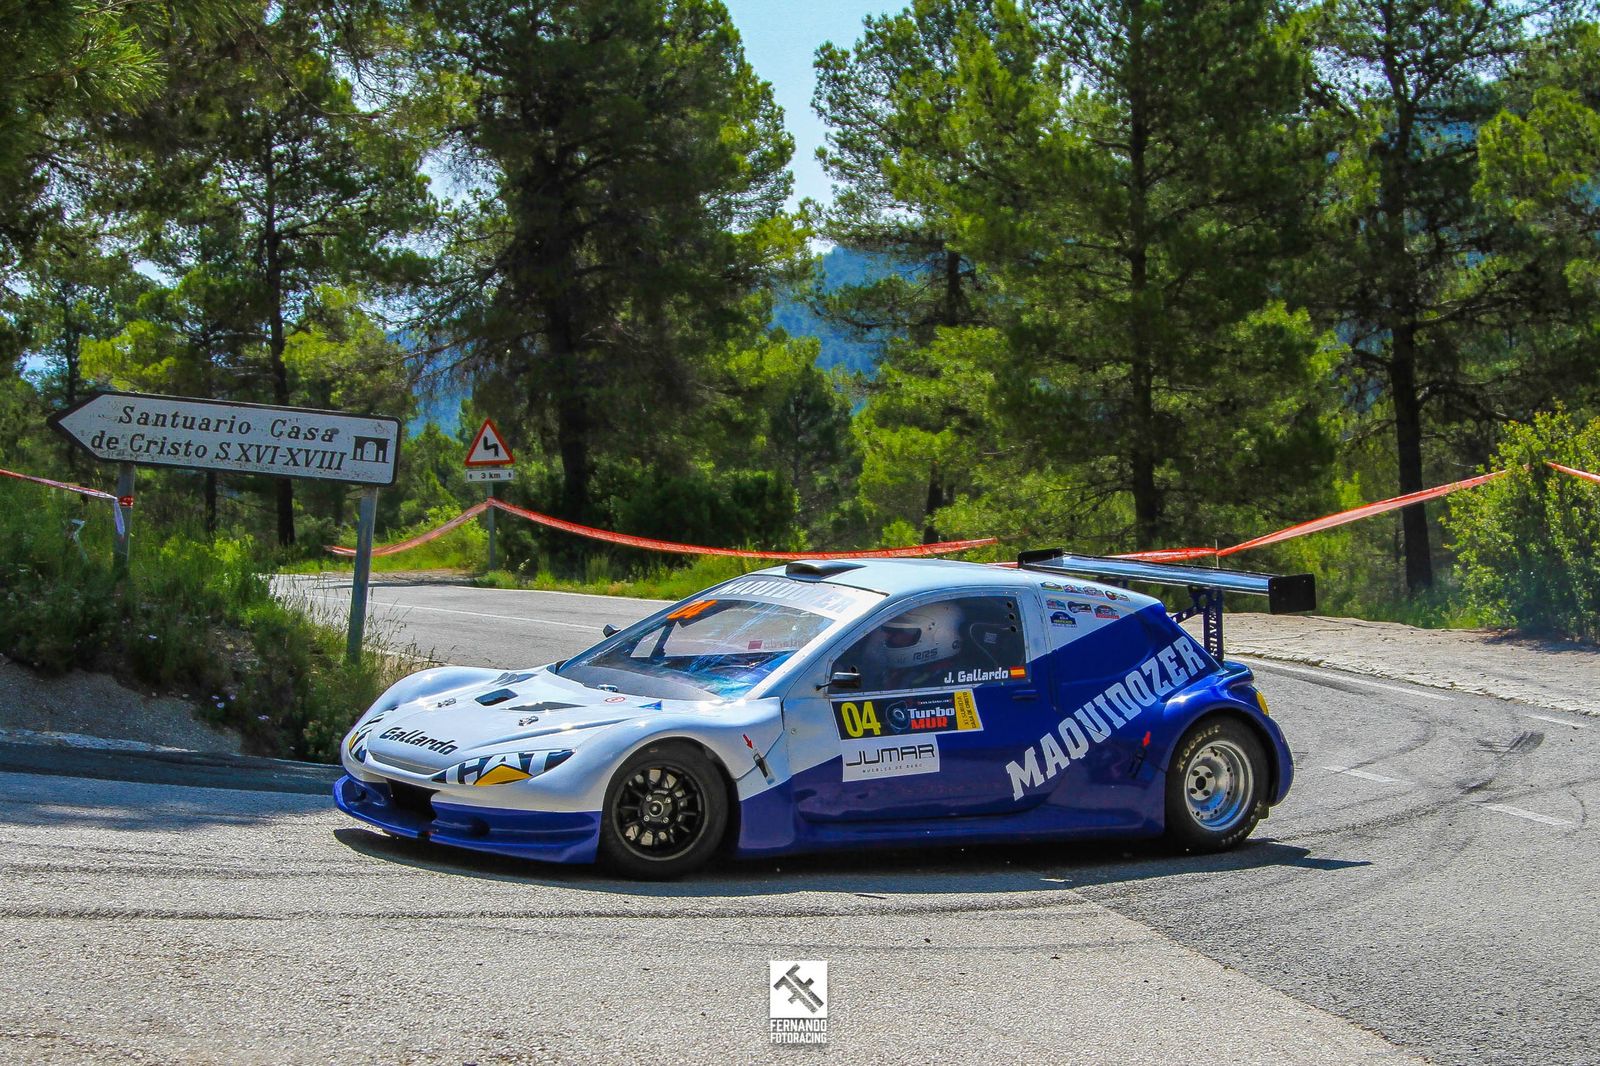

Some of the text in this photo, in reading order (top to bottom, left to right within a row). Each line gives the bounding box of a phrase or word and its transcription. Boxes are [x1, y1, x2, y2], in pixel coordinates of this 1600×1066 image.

[118, 405, 336, 443] Santuario Casa
[90, 430, 119, 450] de
[130, 433, 208, 458] Cristo
[944, 667, 1009, 684] J. Gallardo
[841, 701, 882, 738] 04
[907, 706, 955, 719] Turbo
[911, 717, 948, 729] MUR
[1005, 636, 1206, 801] MAQUIDOZER
[378, 726, 459, 756] Gallardo
[846, 743, 935, 767] JUMAR
